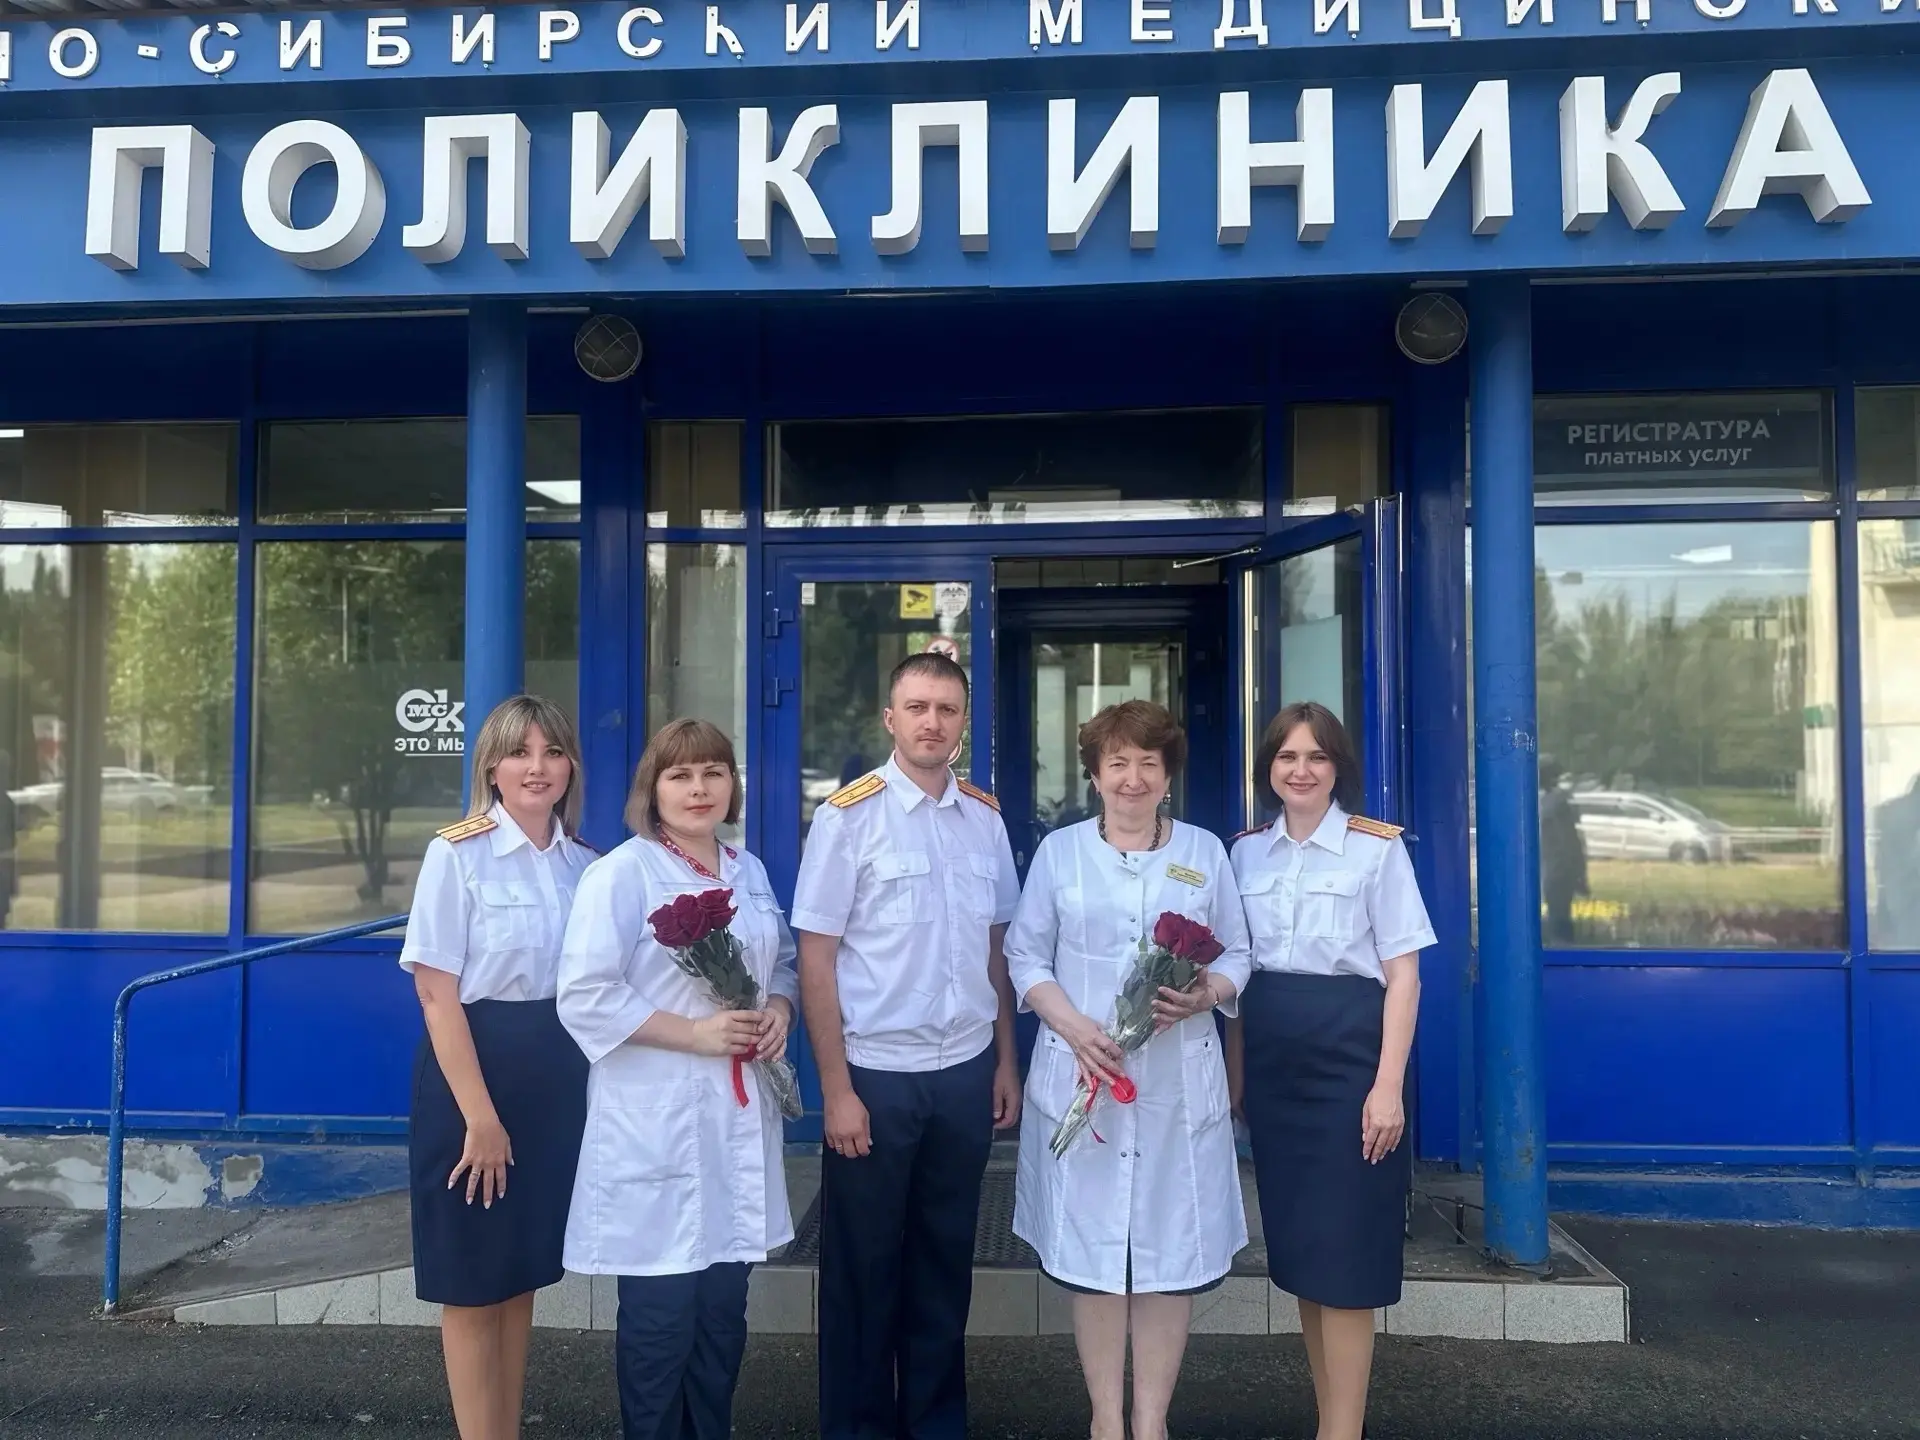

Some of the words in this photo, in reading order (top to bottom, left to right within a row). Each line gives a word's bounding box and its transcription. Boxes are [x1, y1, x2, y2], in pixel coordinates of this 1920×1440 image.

[85, 68, 1873, 270] ПОЛИКЛИНИКА
[1567, 419, 1771, 444] РЕГИСТРАТУРА
[1585, 449, 1683, 466] платных
[1688, 447, 1752, 467] услуг
[394, 737, 430, 752] ЭТО
